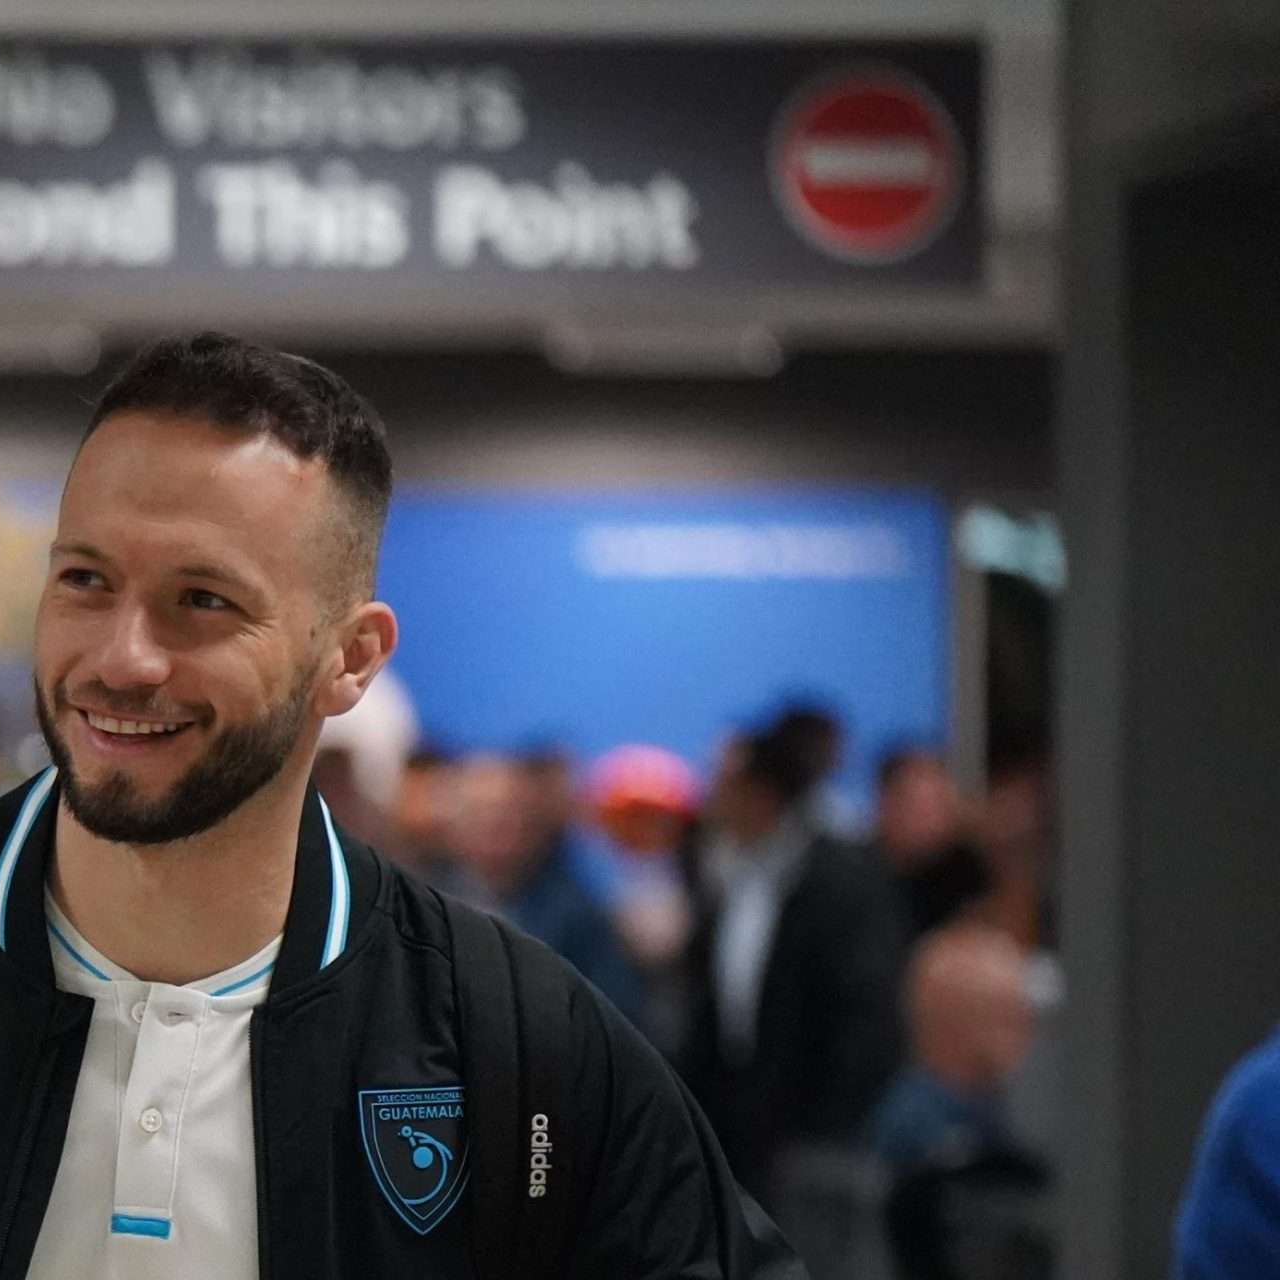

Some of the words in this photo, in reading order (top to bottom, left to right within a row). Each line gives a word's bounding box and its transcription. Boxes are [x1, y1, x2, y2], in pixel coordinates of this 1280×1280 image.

[144, 51, 523, 149] Visitors
[200, 160, 408, 267] This
[436, 162, 697, 267] Point
[379, 1105, 464, 1120] GUATEMALA
[529, 1113, 552, 1198] adidas
